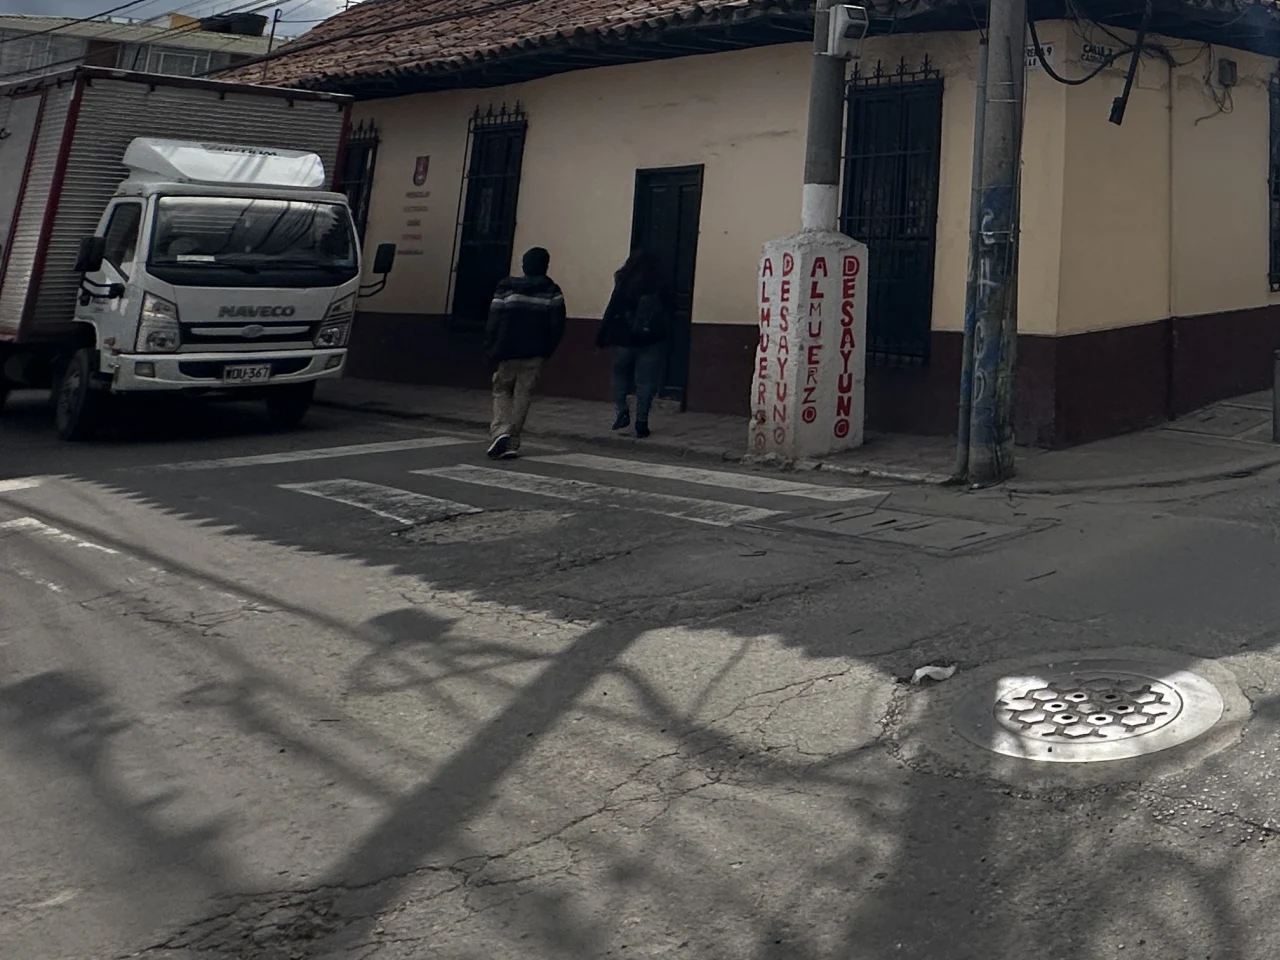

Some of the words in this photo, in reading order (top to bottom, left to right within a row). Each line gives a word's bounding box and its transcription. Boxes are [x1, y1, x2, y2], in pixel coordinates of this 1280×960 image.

[218, 305, 296, 317] NAVECO
[773, 252, 794, 445] DESAYUNO
[802, 256, 828, 424] ALMUERZO
[834, 255, 860, 438] DESAYUNO
